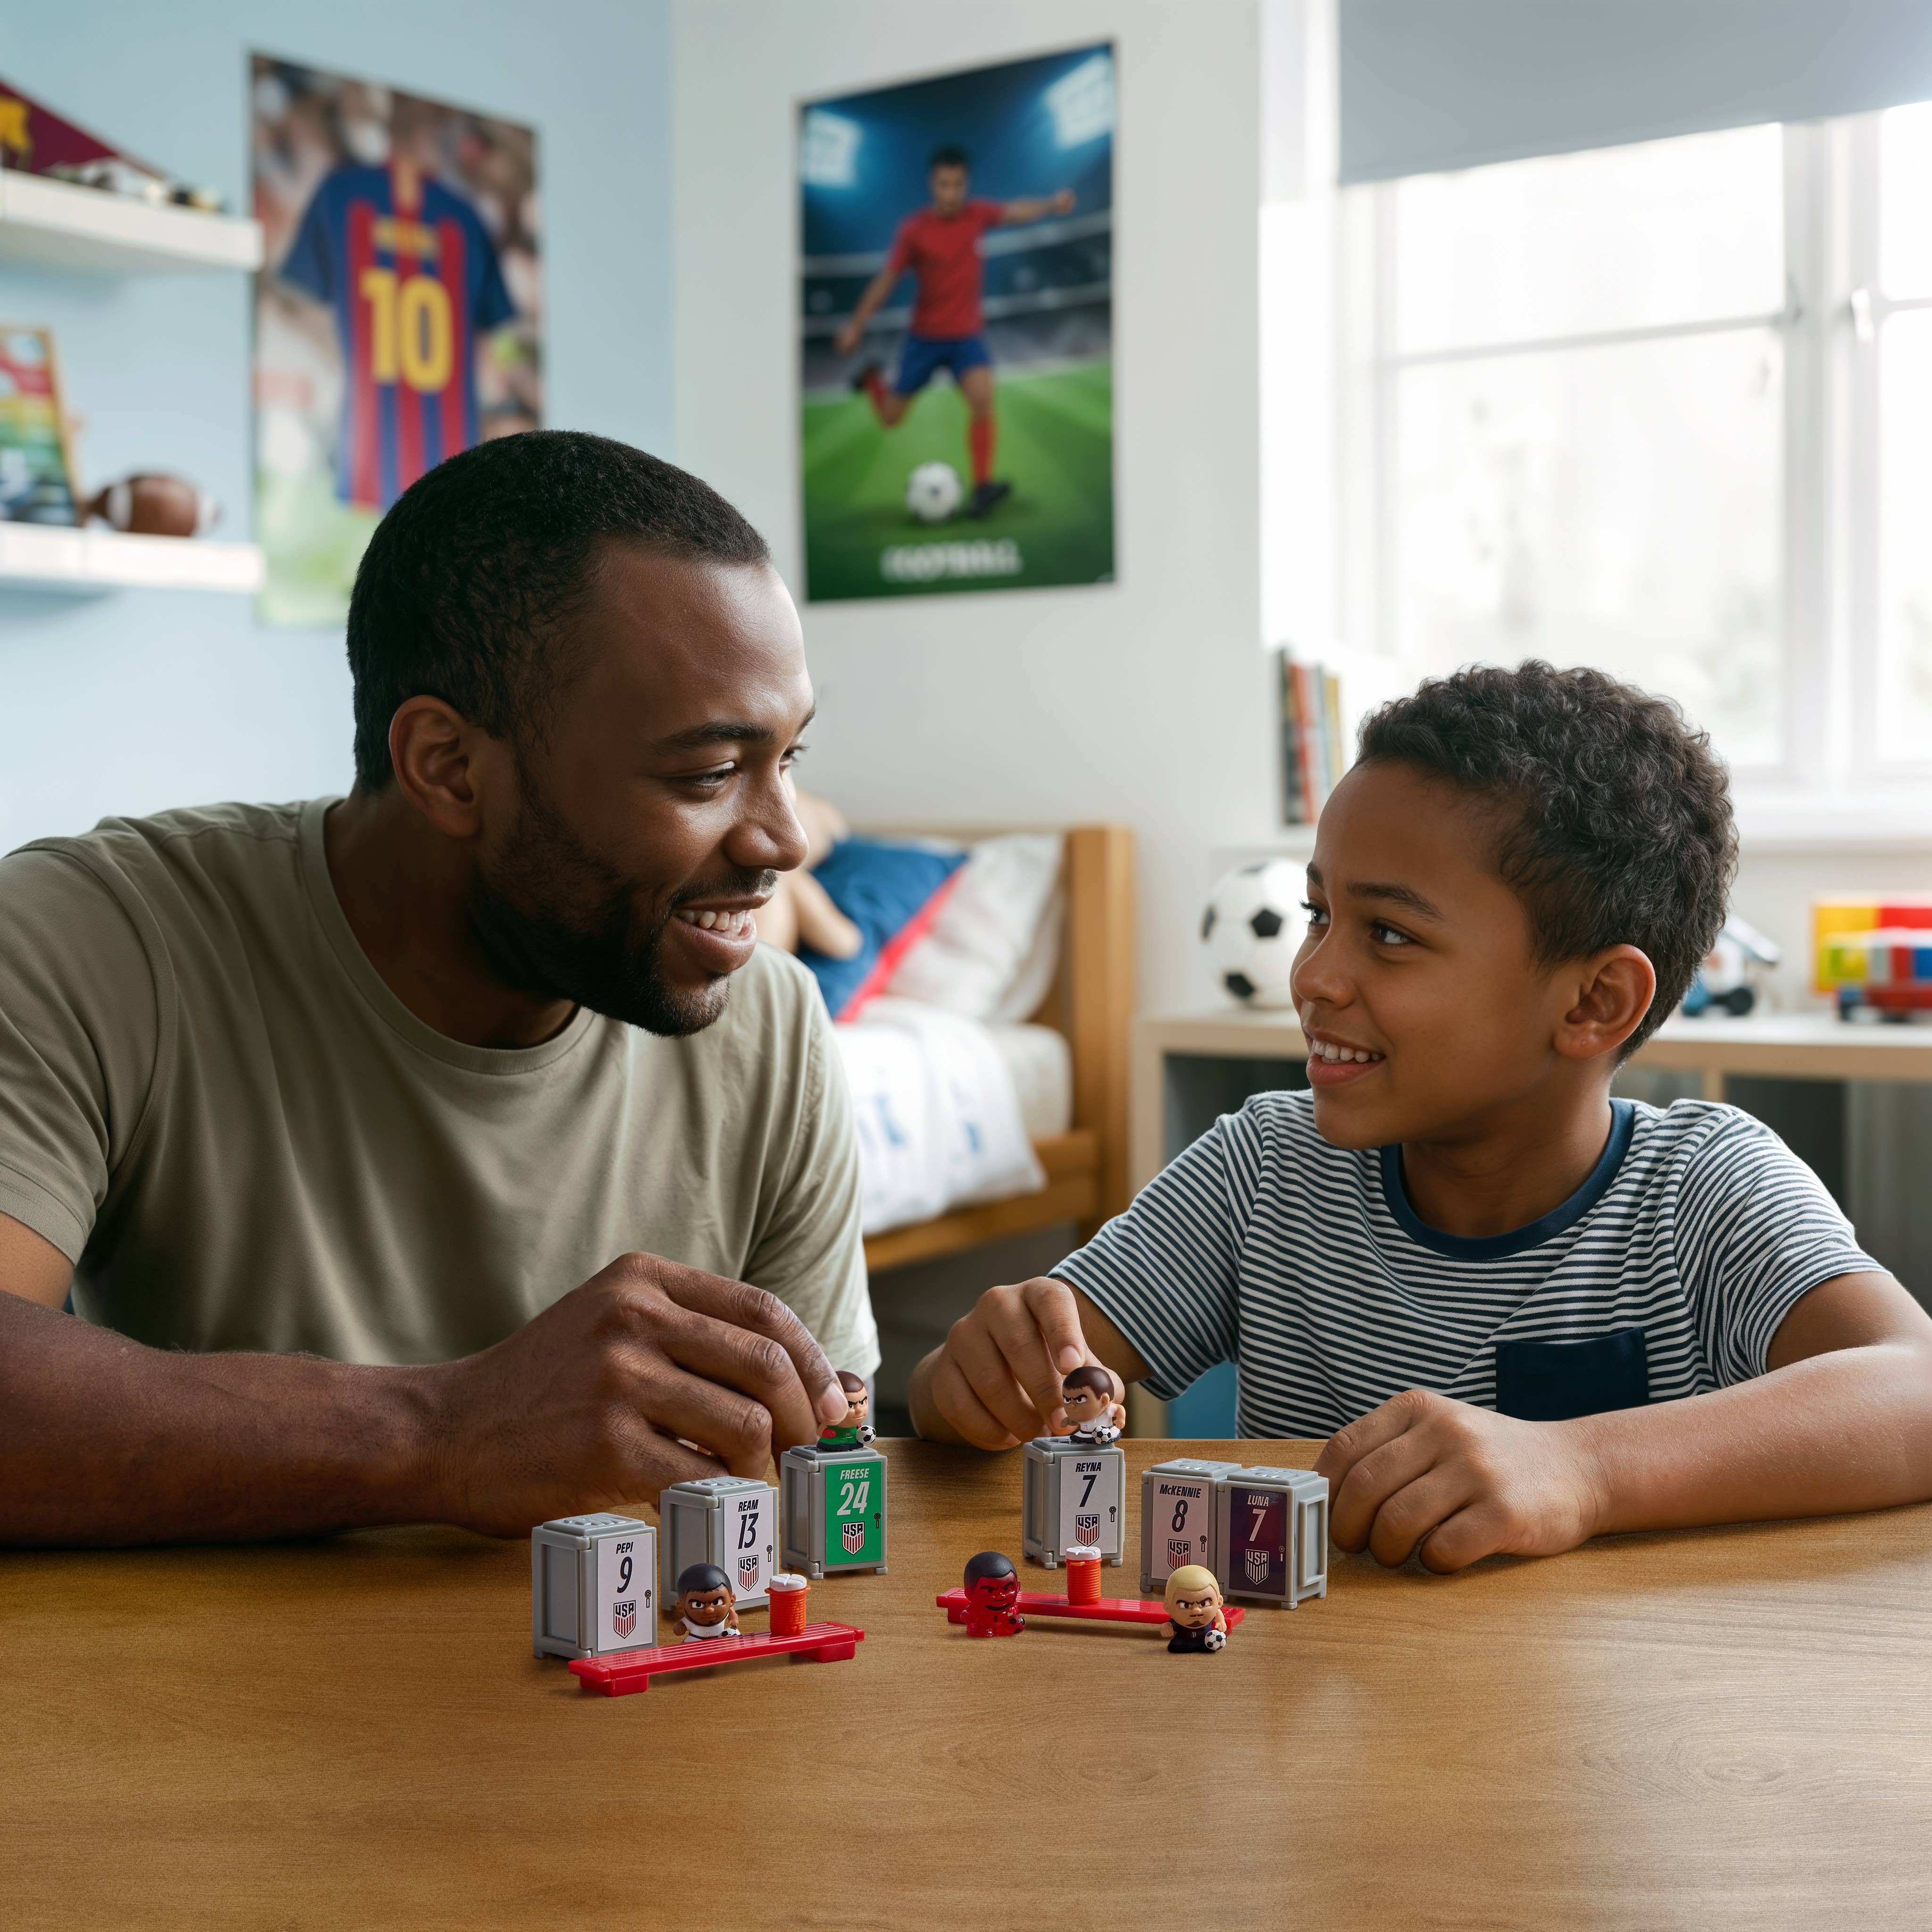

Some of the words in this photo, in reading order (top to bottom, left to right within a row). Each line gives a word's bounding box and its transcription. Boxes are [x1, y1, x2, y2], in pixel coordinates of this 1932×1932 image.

[359, 266, 453, 394] 10
[840, 1468, 870, 1480] FREESE
[1075, 1462, 1102, 1472] REYNA
[1079, 1474, 1097, 1507] 7
[1159, 1484, 1202, 1499] McKENNIE
[738, 1499, 759, 1512] REAM
[837, 1481, 870, 1516] 24
[1247, 1495, 1269, 1507] LUNA
[1078, 1516, 1098, 1529] USA
[1172, 1499, 1188, 1532] 8
[738, 1512, 759, 1550] 13
[843, 1523, 863, 1537] USA
[1249, 1508, 1266, 1541] 7
[616, 1541, 634, 1554] PEPI
[1170, 1541, 1189, 1555] USA
[740, 1557, 757, 1572] USA
[1247, 1551, 1267, 1565] USA
[616, 1556, 633, 1593] 9
[615, 1602, 634, 1618] USA
